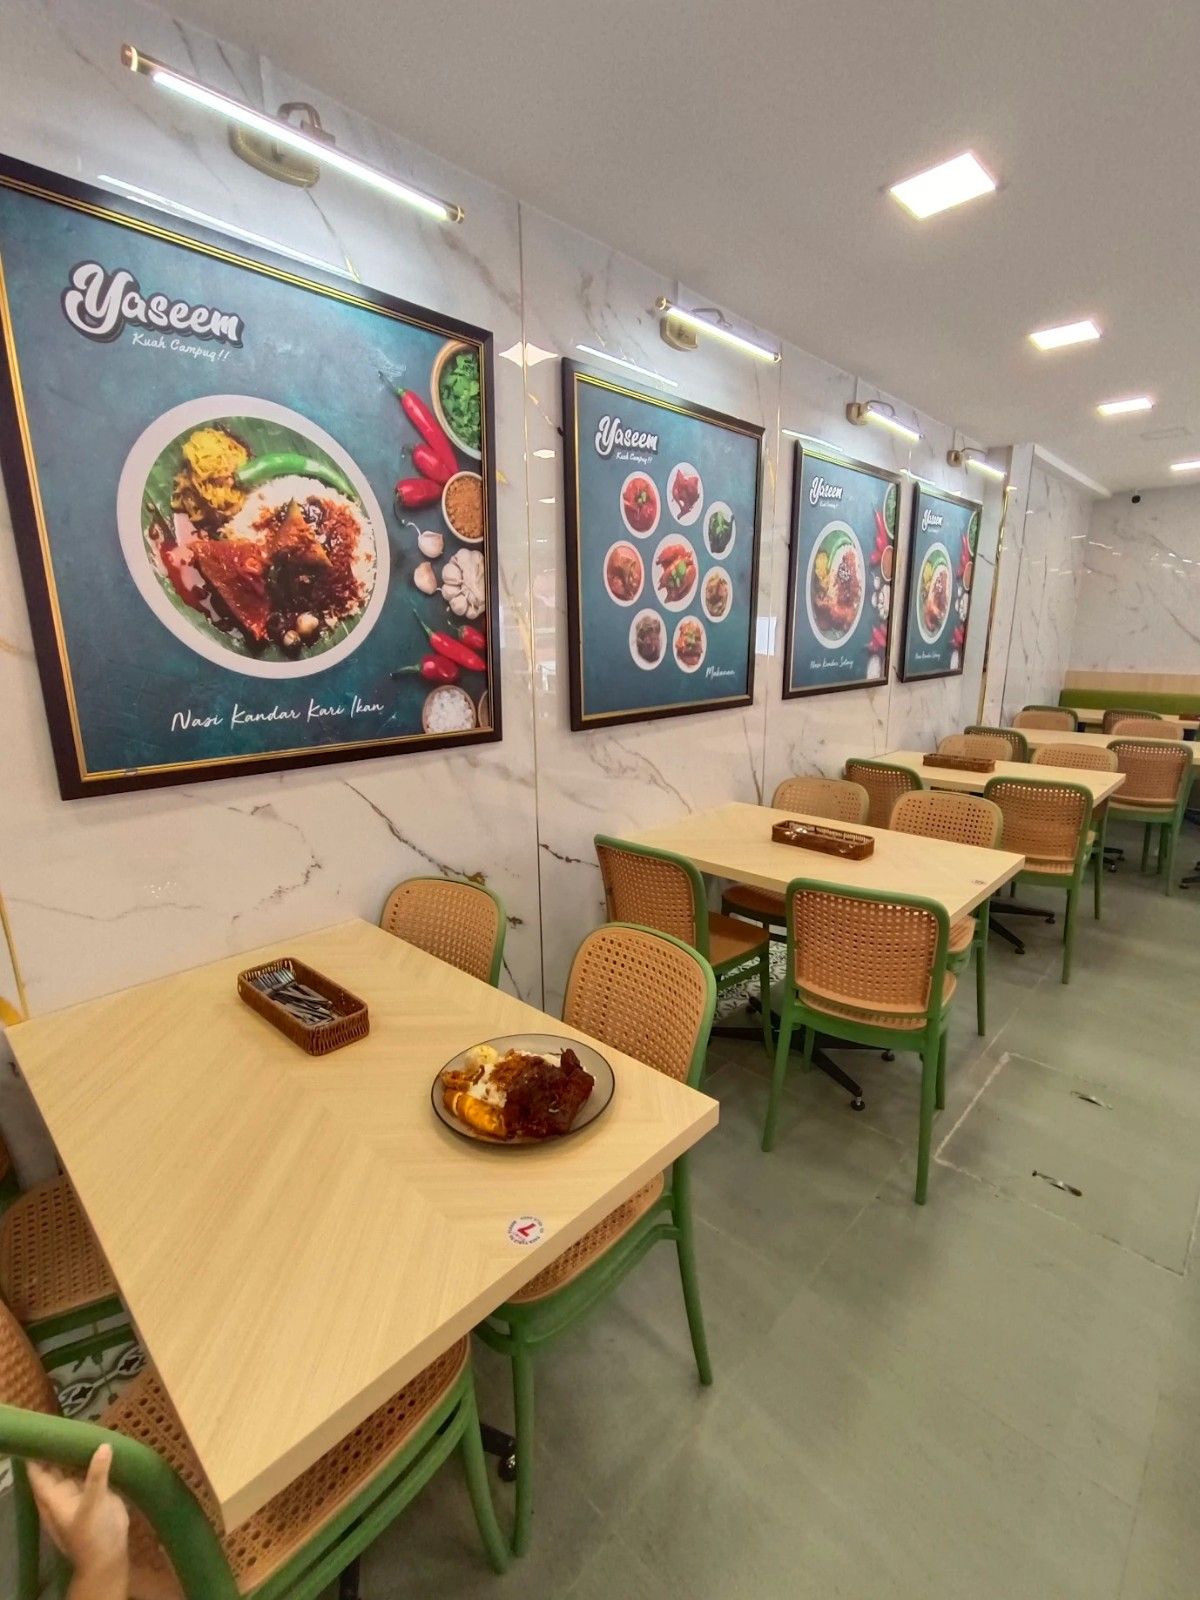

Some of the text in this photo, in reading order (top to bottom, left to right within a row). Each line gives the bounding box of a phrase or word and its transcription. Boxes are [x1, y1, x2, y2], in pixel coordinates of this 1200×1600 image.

[62, 261, 243, 347] Yaseem
[131, 332, 166, 349] Kuah
[595, 415, 659, 457] Yaseem
[171, 695, 384, 731] Nasi Kandar Kari Ikan
